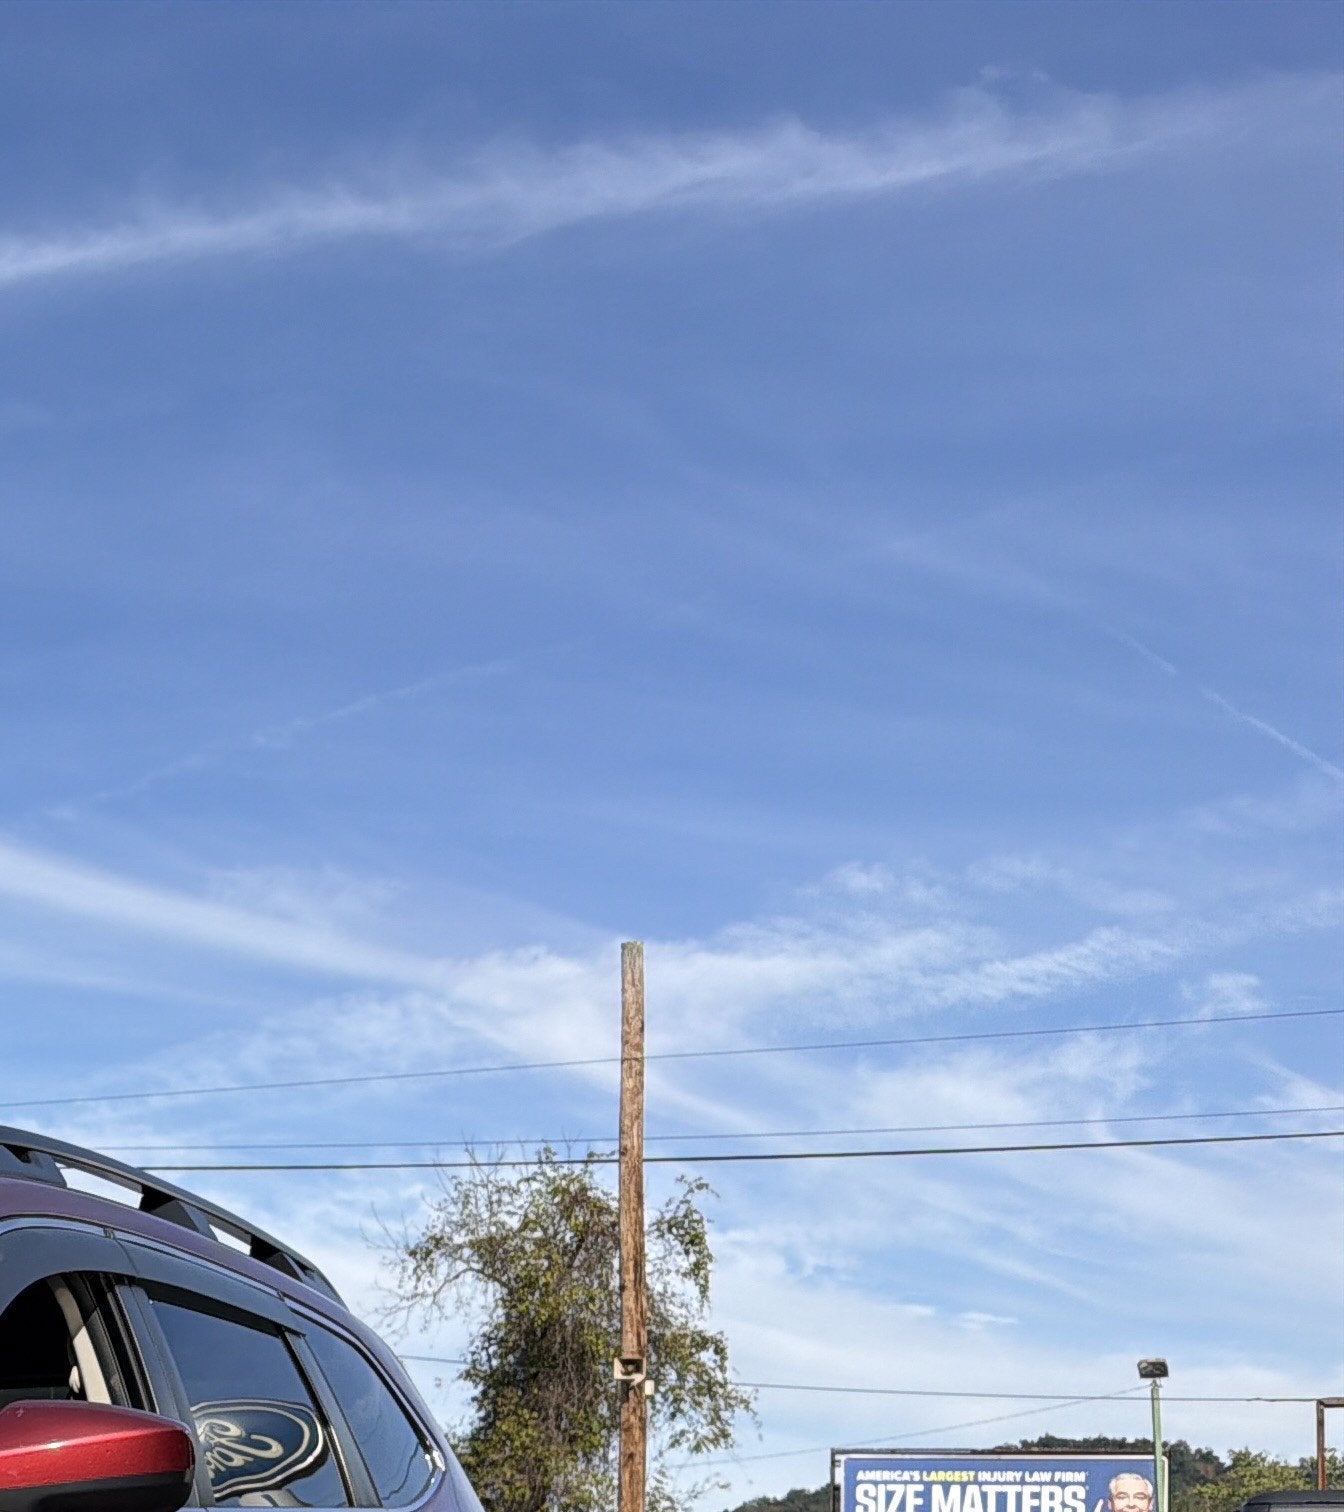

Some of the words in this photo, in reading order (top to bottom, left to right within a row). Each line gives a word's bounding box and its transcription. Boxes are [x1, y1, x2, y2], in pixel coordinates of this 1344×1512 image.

[855, 1469, 921, 1482] AMERICA'S
[922, 1470, 976, 1482] LARGEST
[977, 1470, 1024, 1483] INJURY
[1024, 1470, 1053, 1483] LAW
[1053, 1470, 1087, 1483] FIRM
